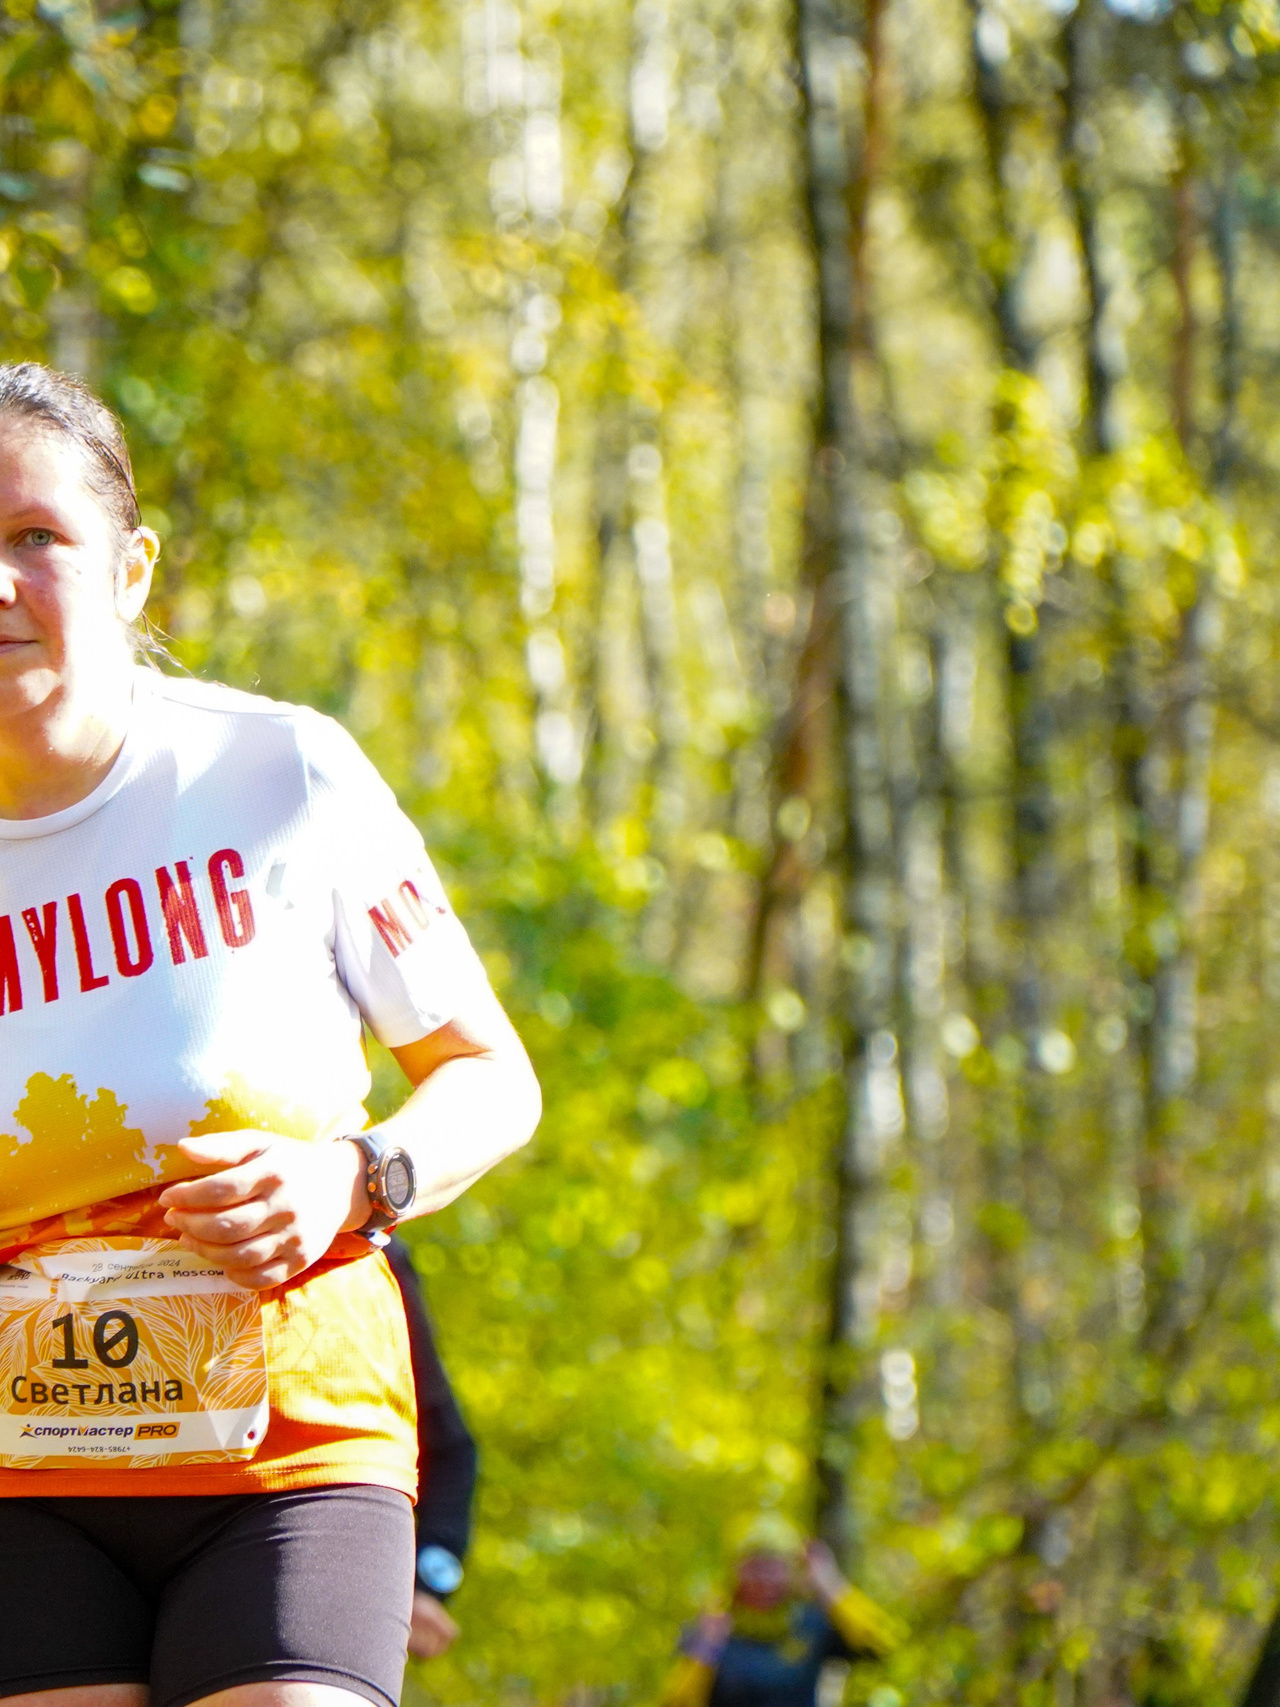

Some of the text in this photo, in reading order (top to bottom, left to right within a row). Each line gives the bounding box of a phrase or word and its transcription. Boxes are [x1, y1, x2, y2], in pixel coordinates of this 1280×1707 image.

[367, 880, 446, 959] MO
[92, 1263, 104, 1273] 28
[157, 1258, 181, 1267] 2024
[125, 1269, 165, 1281] Ultra
[173, 1268, 225, 1278] Moscow
[51, 1309, 140, 1370] 10
[10, 1374, 184, 1405] Светлана
[137, 1424, 177, 1438] PRO
